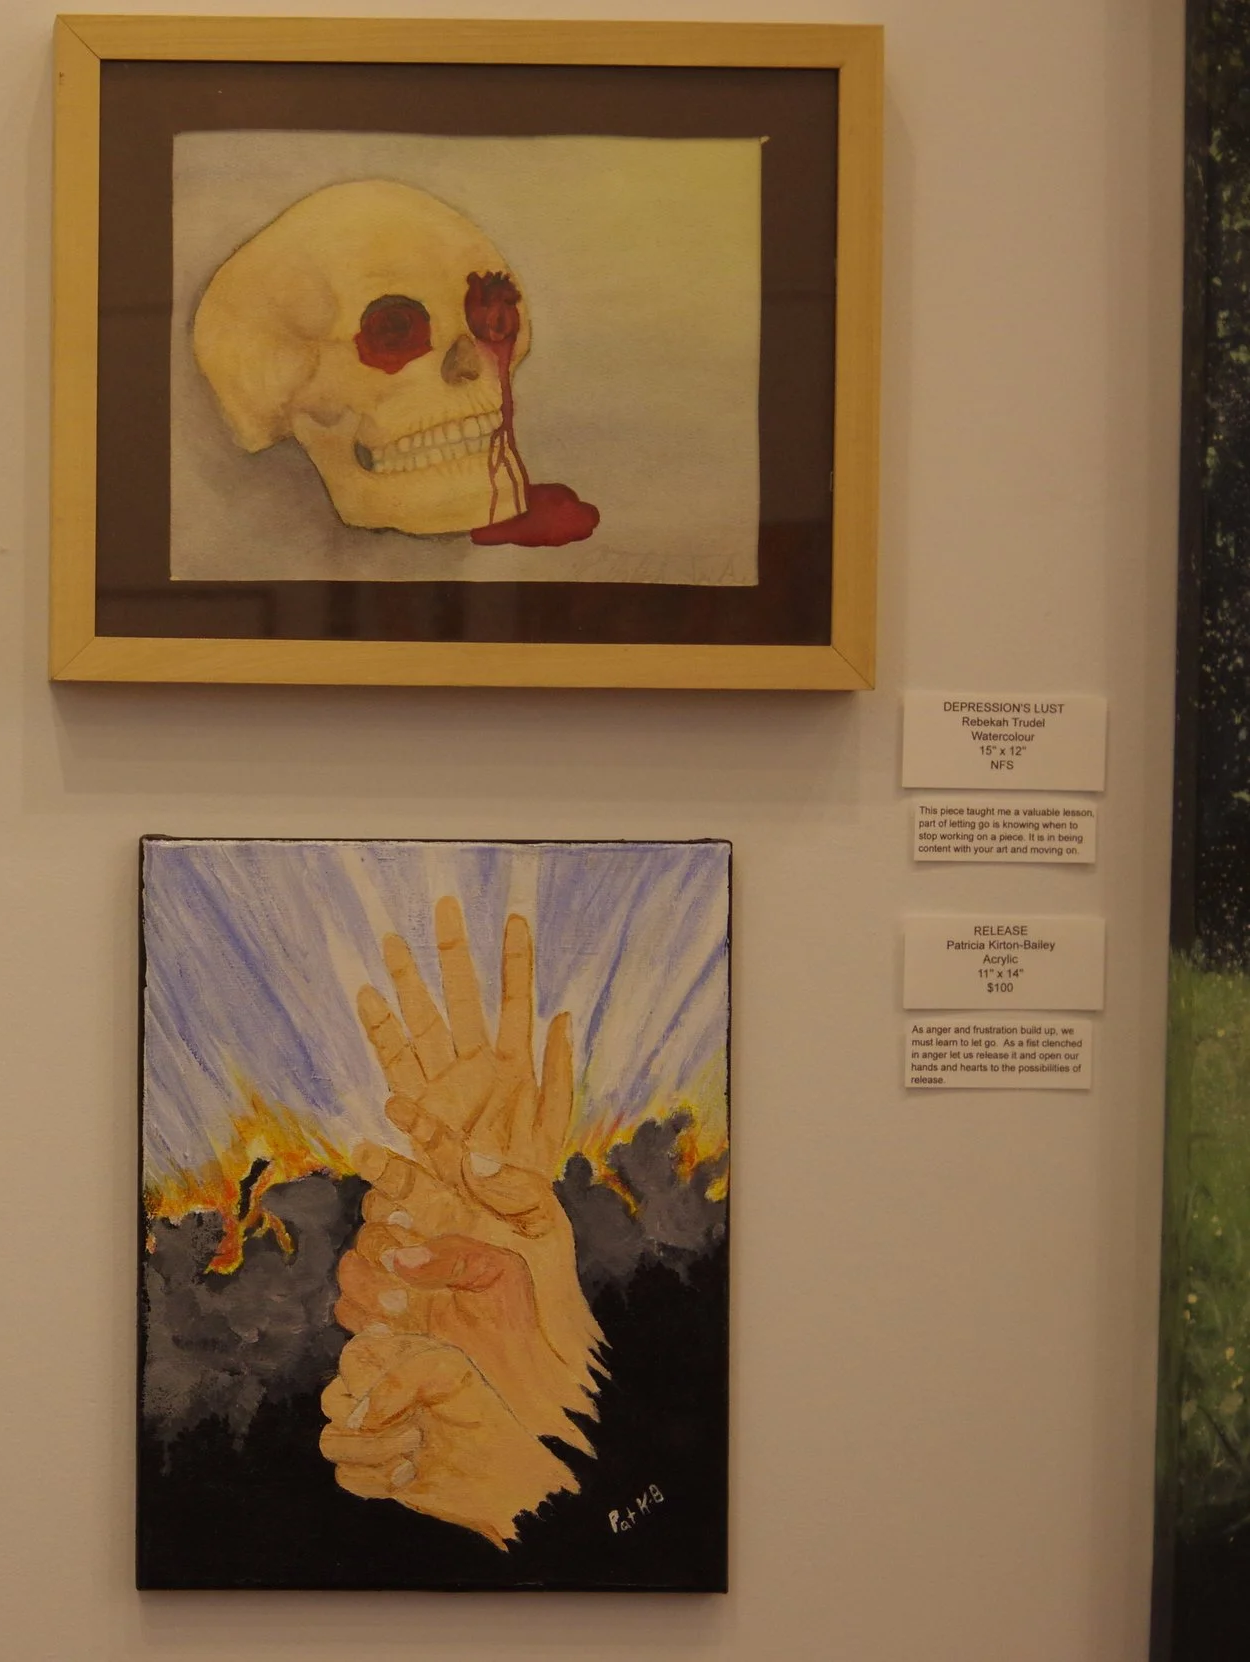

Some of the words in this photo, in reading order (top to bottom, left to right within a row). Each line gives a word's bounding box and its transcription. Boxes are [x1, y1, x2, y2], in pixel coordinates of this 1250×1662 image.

[1034, 704, 1064, 714] LUST
[962, 716, 1008, 727] Rebekah
[1012, 717, 1045, 727] Trudel
[971, 731, 1034, 742] Watercolour
[991, 760, 1014, 770] NFS
[920, 806, 937, 814] This
[940, 807, 964, 817] piece
[967, 808, 994, 818] taught
[1023, 808, 1060, 816] valuable
[1063, 808, 1094, 817] lesson,
[919, 820, 936, 829] part
[938, 819, 947, 828] of
[949, 820, 976, 830] letting
[978, 821, 990, 830] go
[993, 820, 1000, 828] is
[1003, 820, 1039, 831] knowing
[918, 844, 951, 852] content
[953, 845, 971, 853] with
[974, 846, 994, 855] your
[1010, 845, 1028, 853] and
[1030, 847, 1063, 856] moving
[974, 926, 1028, 936] RELEASE
[947, 940, 985, 950] Patricia
[989, 940, 1055, 952] Kirton-Bailey
[983, 954, 1018, 966] Acrylic
[987, 982, 1013, 993] $100
[912, 1025, 923, 1033] As
[926, 1027, 951, 1036] anger
[954, 1026, 970, 1034] and
[973, 1025, 1018, 1034] frustration
[1020, 1026, 1041, 1034] build
[1044, 1028, 1058, 1036] up,
[922, 1052, 947, 1061] anger
[950, 1051, 960, 1059] let
[976, 1051, 1009, 1060] release
[1038, 1053, 1061, 1061] open
[911, 1063, 938, 1071] hands
[941, 1063, 957, 1071] and
[960, 1063, 988, 1072] hearts
[990, 1064, 999, 1072] to
[1002, 1064, 1016, 1072] the
[1018, 1064, 1070, 1074] possibilities
[1072, 1064, 1081, 1072] of
[911, 1076, 945, 1084] release.
